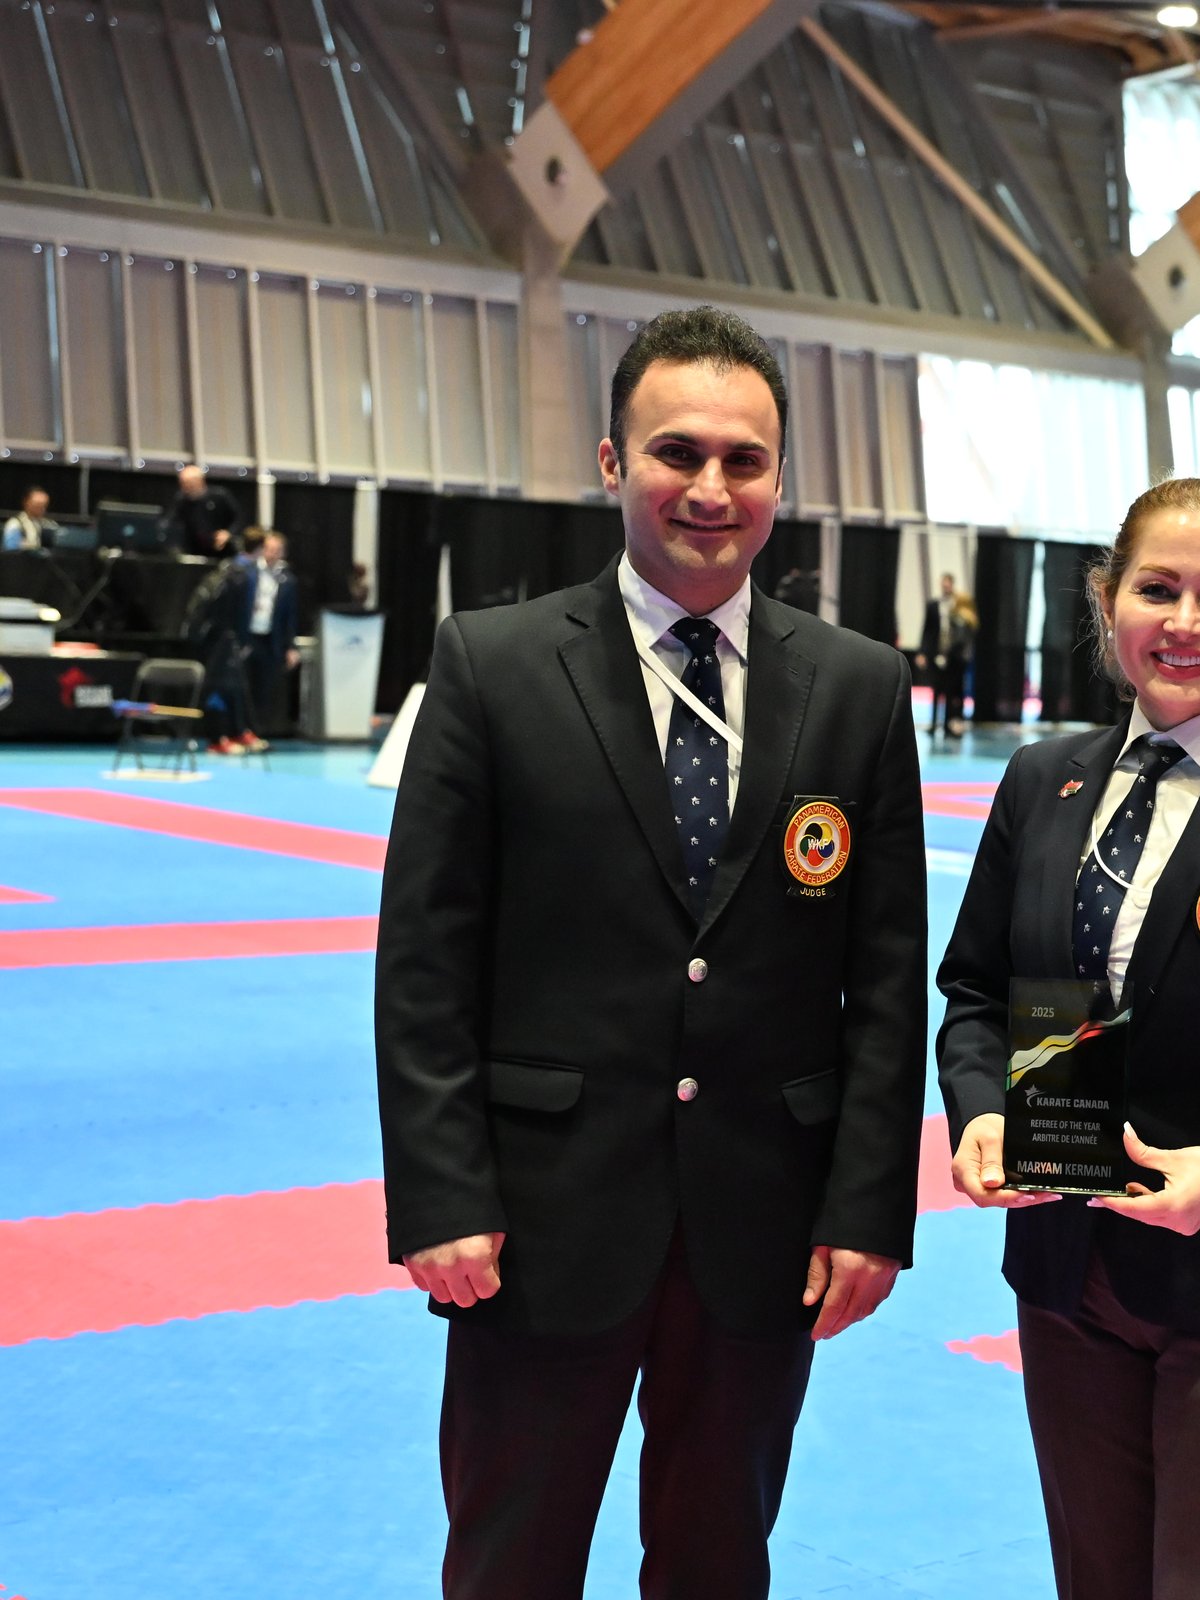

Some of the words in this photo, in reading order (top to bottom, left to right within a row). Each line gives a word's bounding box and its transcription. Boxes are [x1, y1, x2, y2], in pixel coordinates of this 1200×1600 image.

[793, 805, 846, 829] PANAMERICAN
[807, 838, 830, 850] WKF
[786, 848, 806, 880] KARATE
[807, 850, 847, 884] FEDERATION
[800, 887, 826, 897] JUDGE
[1031, 1006, 1055, 1018] 2025
[1036, 1096, 1071, 1108] KARATE
[1073, 1098, 1110, 1110] CANADA
[1030, 1119, 1058, 1129] REFEREE
[1059, 1120, 1069, 1129] OF
[1069, 1120, 1082, 1130] THE
[1083, 1121, 1100, 1131] YEAR
[1032, 1133, 1060, 1143] ARBITRE
[1060, 1134, 1070, 1144] DE
[1017, 1160, 1063, 1175] MARYAM
[1065, 1162, 1112, 1178] KERMANI
